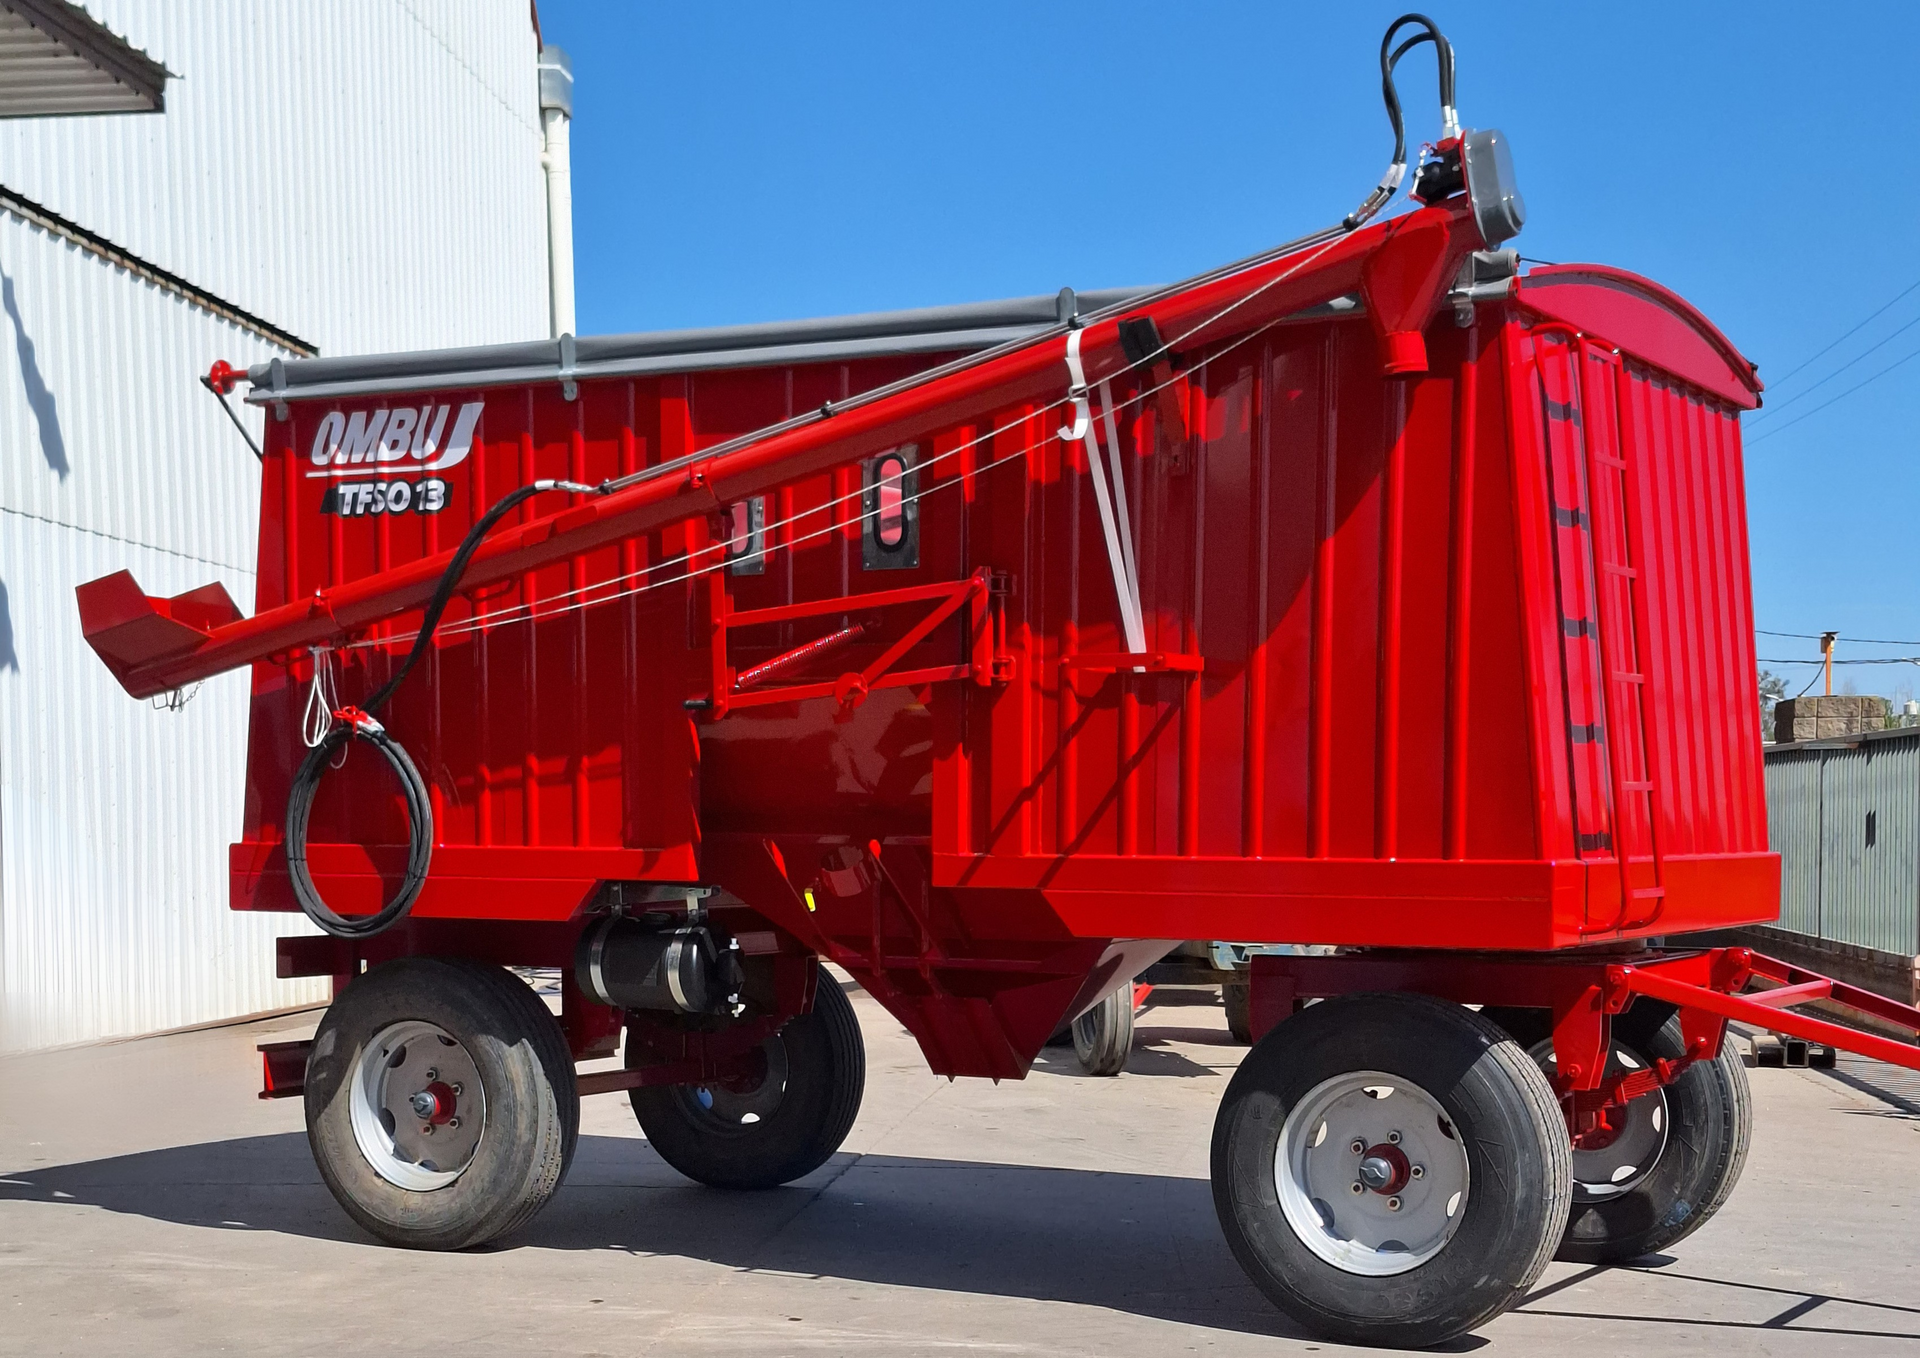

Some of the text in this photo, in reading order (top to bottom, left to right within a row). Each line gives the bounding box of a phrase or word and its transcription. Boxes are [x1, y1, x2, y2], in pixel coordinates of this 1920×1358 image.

[310, 404, 452, 466] OMBU
[338, 479, 446, 515] TFSO 13
